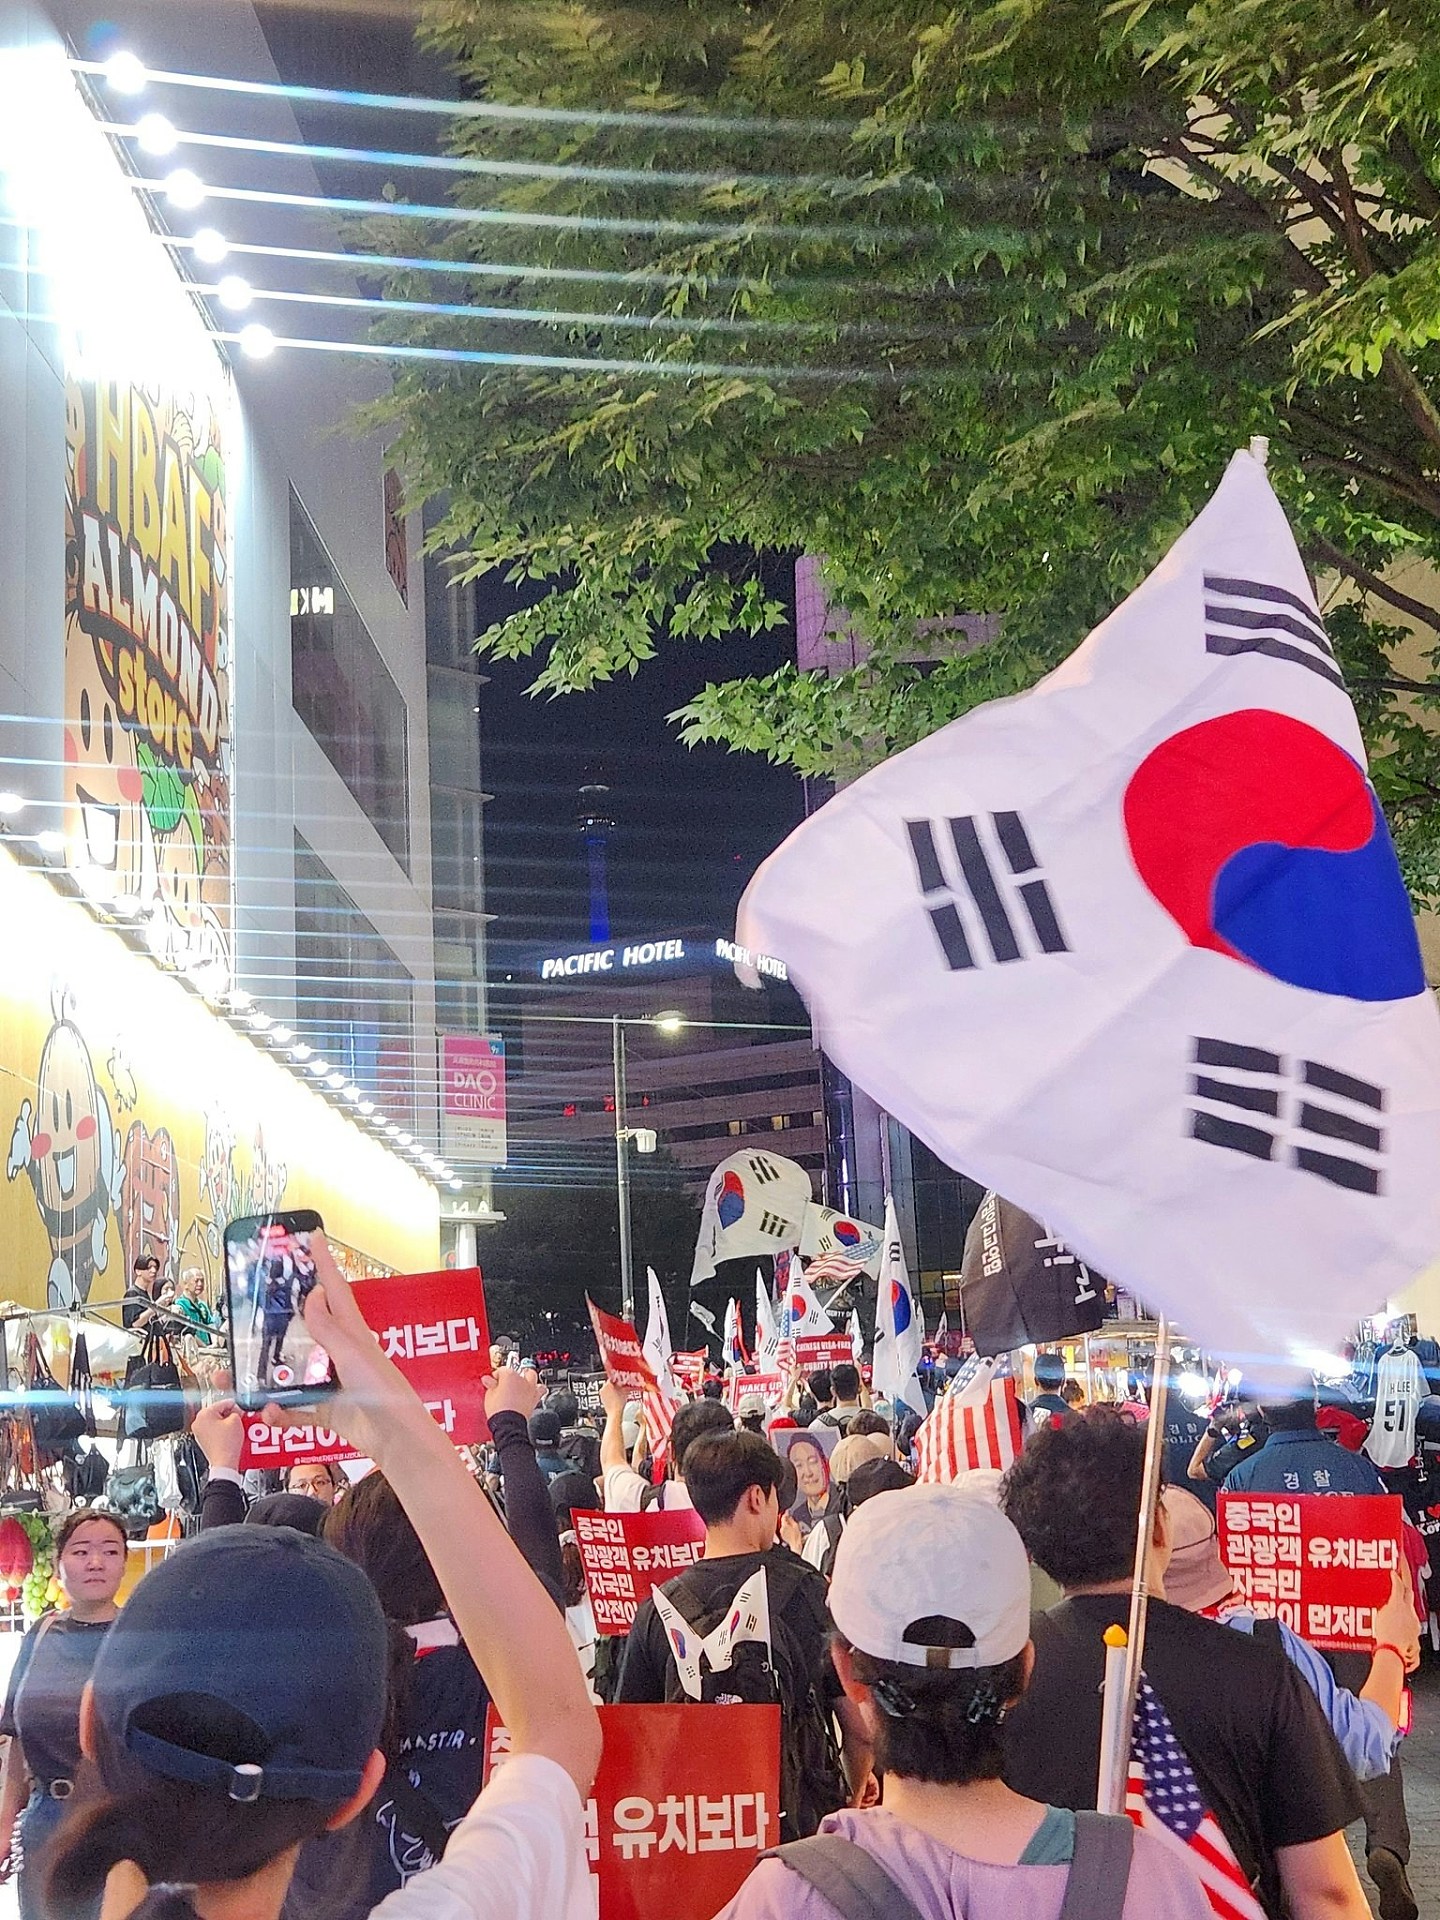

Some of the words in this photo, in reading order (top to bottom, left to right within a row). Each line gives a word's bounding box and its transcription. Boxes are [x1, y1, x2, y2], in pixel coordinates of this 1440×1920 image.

[96, 370, 211, 642] HBAF
[81, 512, 218, 754] ALMOND
[118, 645, 194, 771] store
[541, 949, 615, 979] PACIFIC
[622, 939, 685, 967] HOTEL
[715, 938, 754, 966] PACIFIC
[757, 954, 788, 980] HOTEL
[454, 1093, 496, 1110] CLINIC
[371, 1316, 481, 1360] 치보다
[739, 1381, 767, 1393] WAKE
[1384, 1400, 1407, 1432] 51
[576, 1516, 626, 1544] 중국인
[1225, 1501, 1301, 1534] 중국인
[582, 1543, 631, 1571] 관광객
[1227, 1534, 1302, 1567] 관광객
[1307, 1537, 1399, 1570] 유치보다
[588, 1571, 636, 1599] 자국민
[1229, 1568, 1301, 1601] 자국민
[612, 1792, 770, 1860] 유치보다
